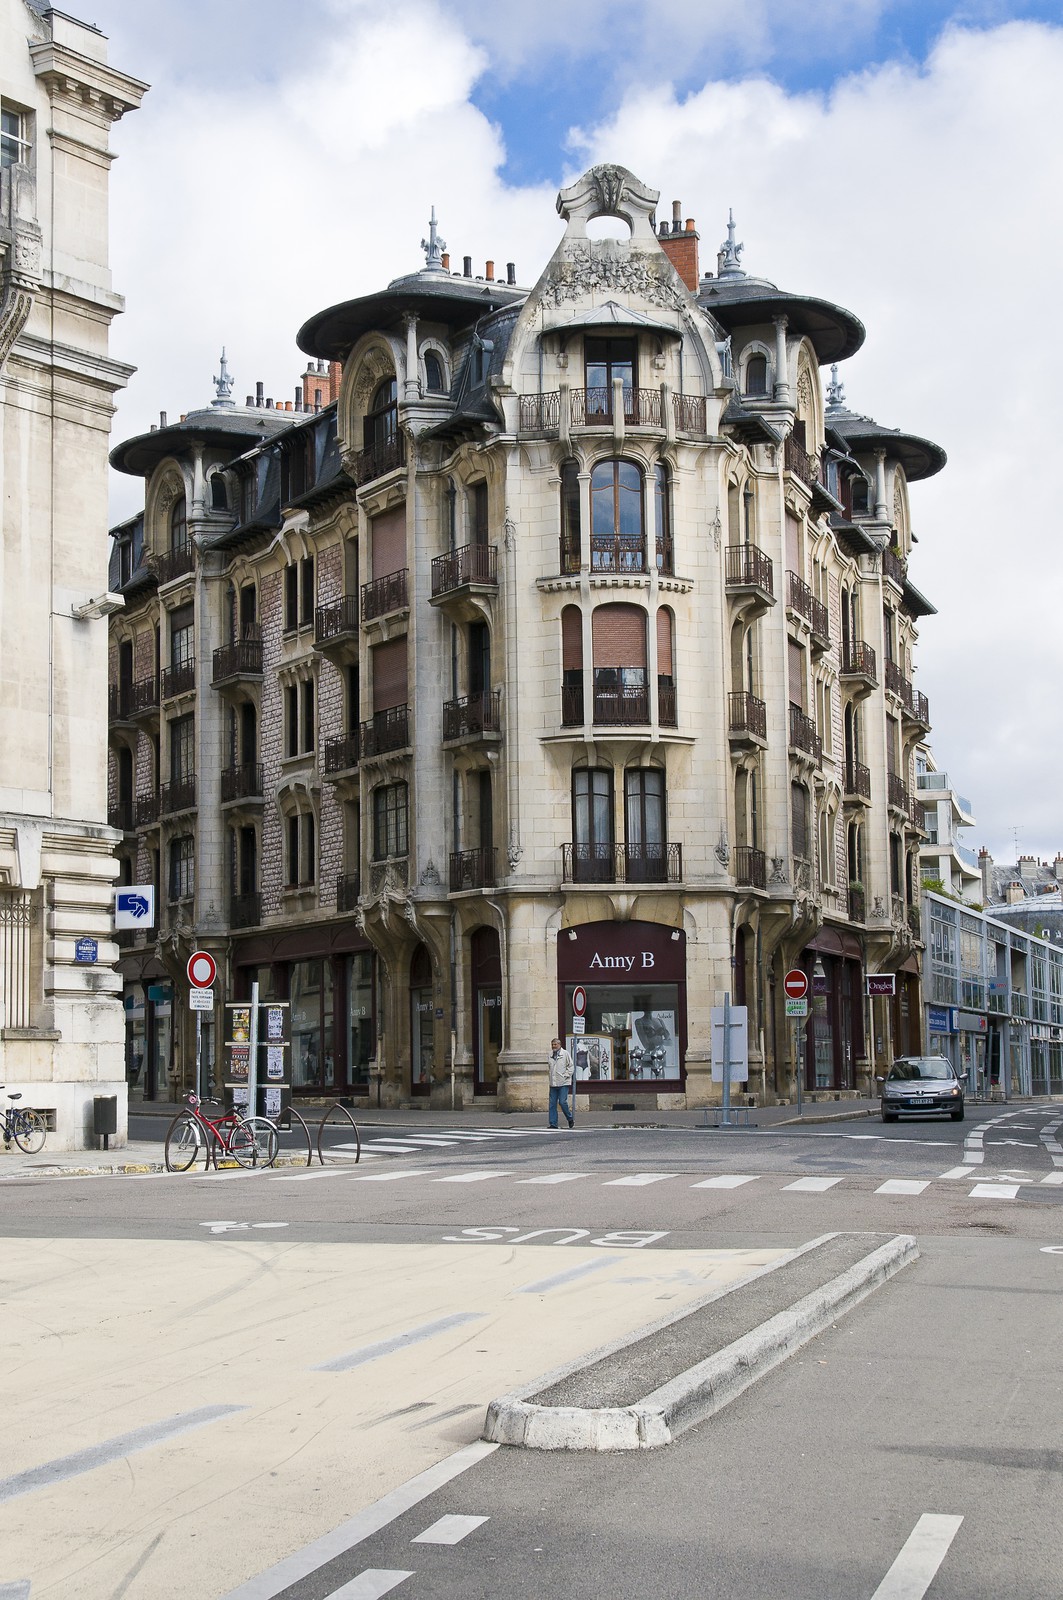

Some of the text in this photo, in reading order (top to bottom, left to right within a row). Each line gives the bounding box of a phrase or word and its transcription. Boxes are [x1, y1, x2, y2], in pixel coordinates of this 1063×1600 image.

[589, 951, 655, 971] Anny B
[869, 981, 893, 991] Ongles
[416, 1002, 429, 1013] Anny
[429, 1000, 434, 1011] B
[482, 995, 502, 1008] Anny B
[441, 1226, 671, 1247] BUS
